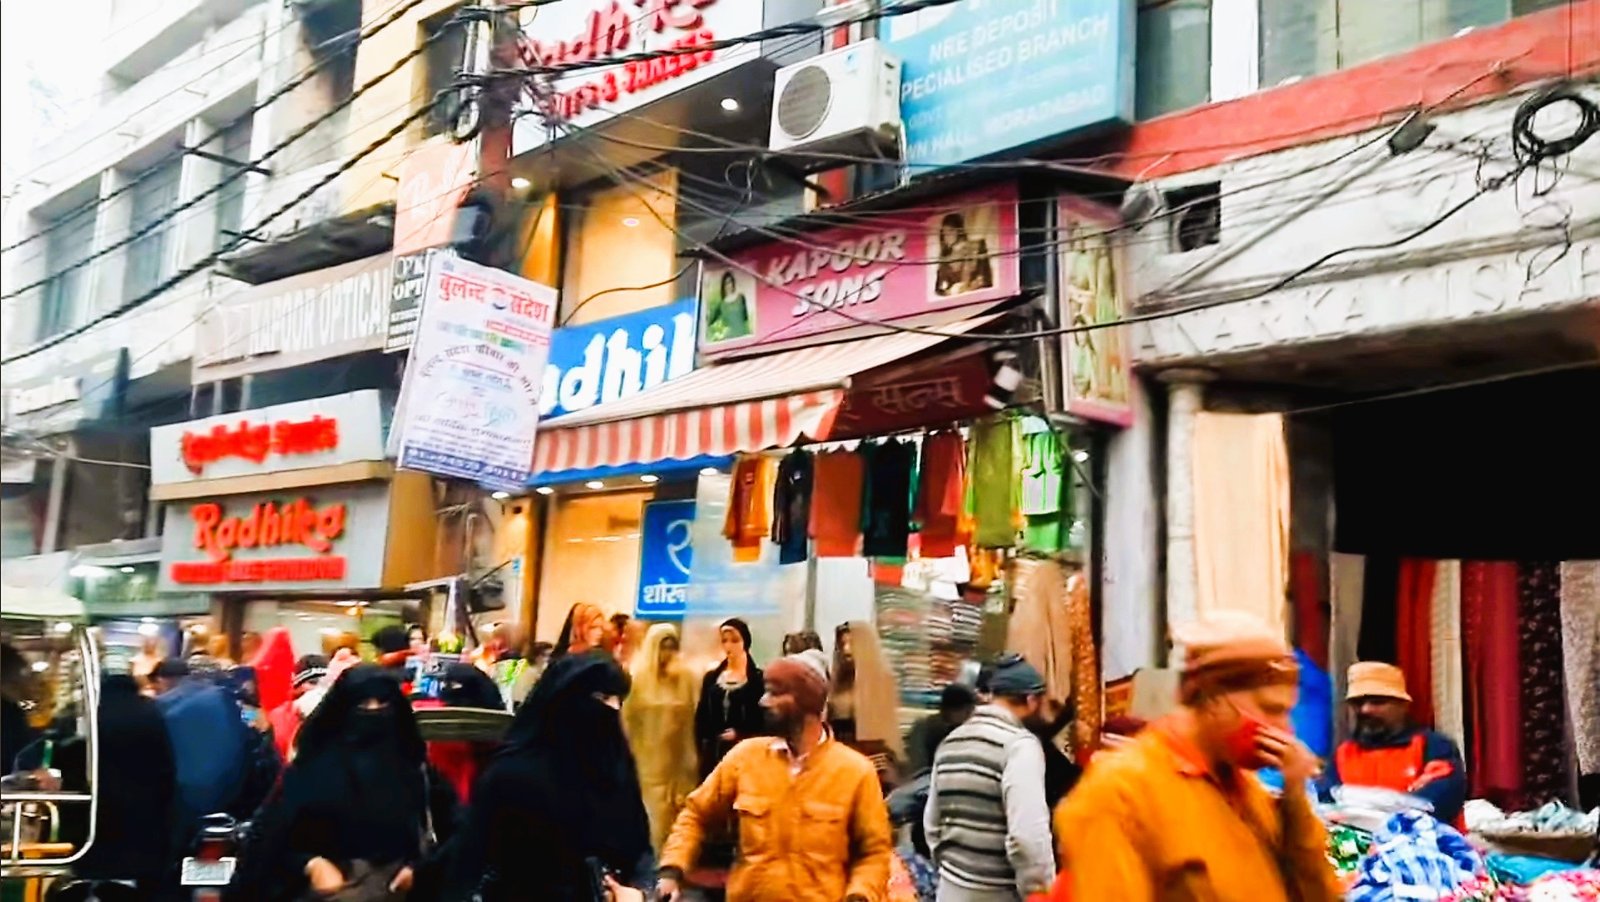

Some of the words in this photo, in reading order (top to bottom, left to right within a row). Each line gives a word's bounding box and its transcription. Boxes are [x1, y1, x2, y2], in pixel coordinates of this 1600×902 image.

[899, 51, 1013, 104] PECIALISED
[1016, 15, 1110, 62] BRANCH
[928, 31, 969, 62] NRE
[969, 0, 1057, 46] DEPOSIT
[764, 227, 906, 288] KAPOOR
[792, 266, 887, 318] SONS
[540, 311, 695, 416] adhi
[189, 497, 346, 563] Radhika
